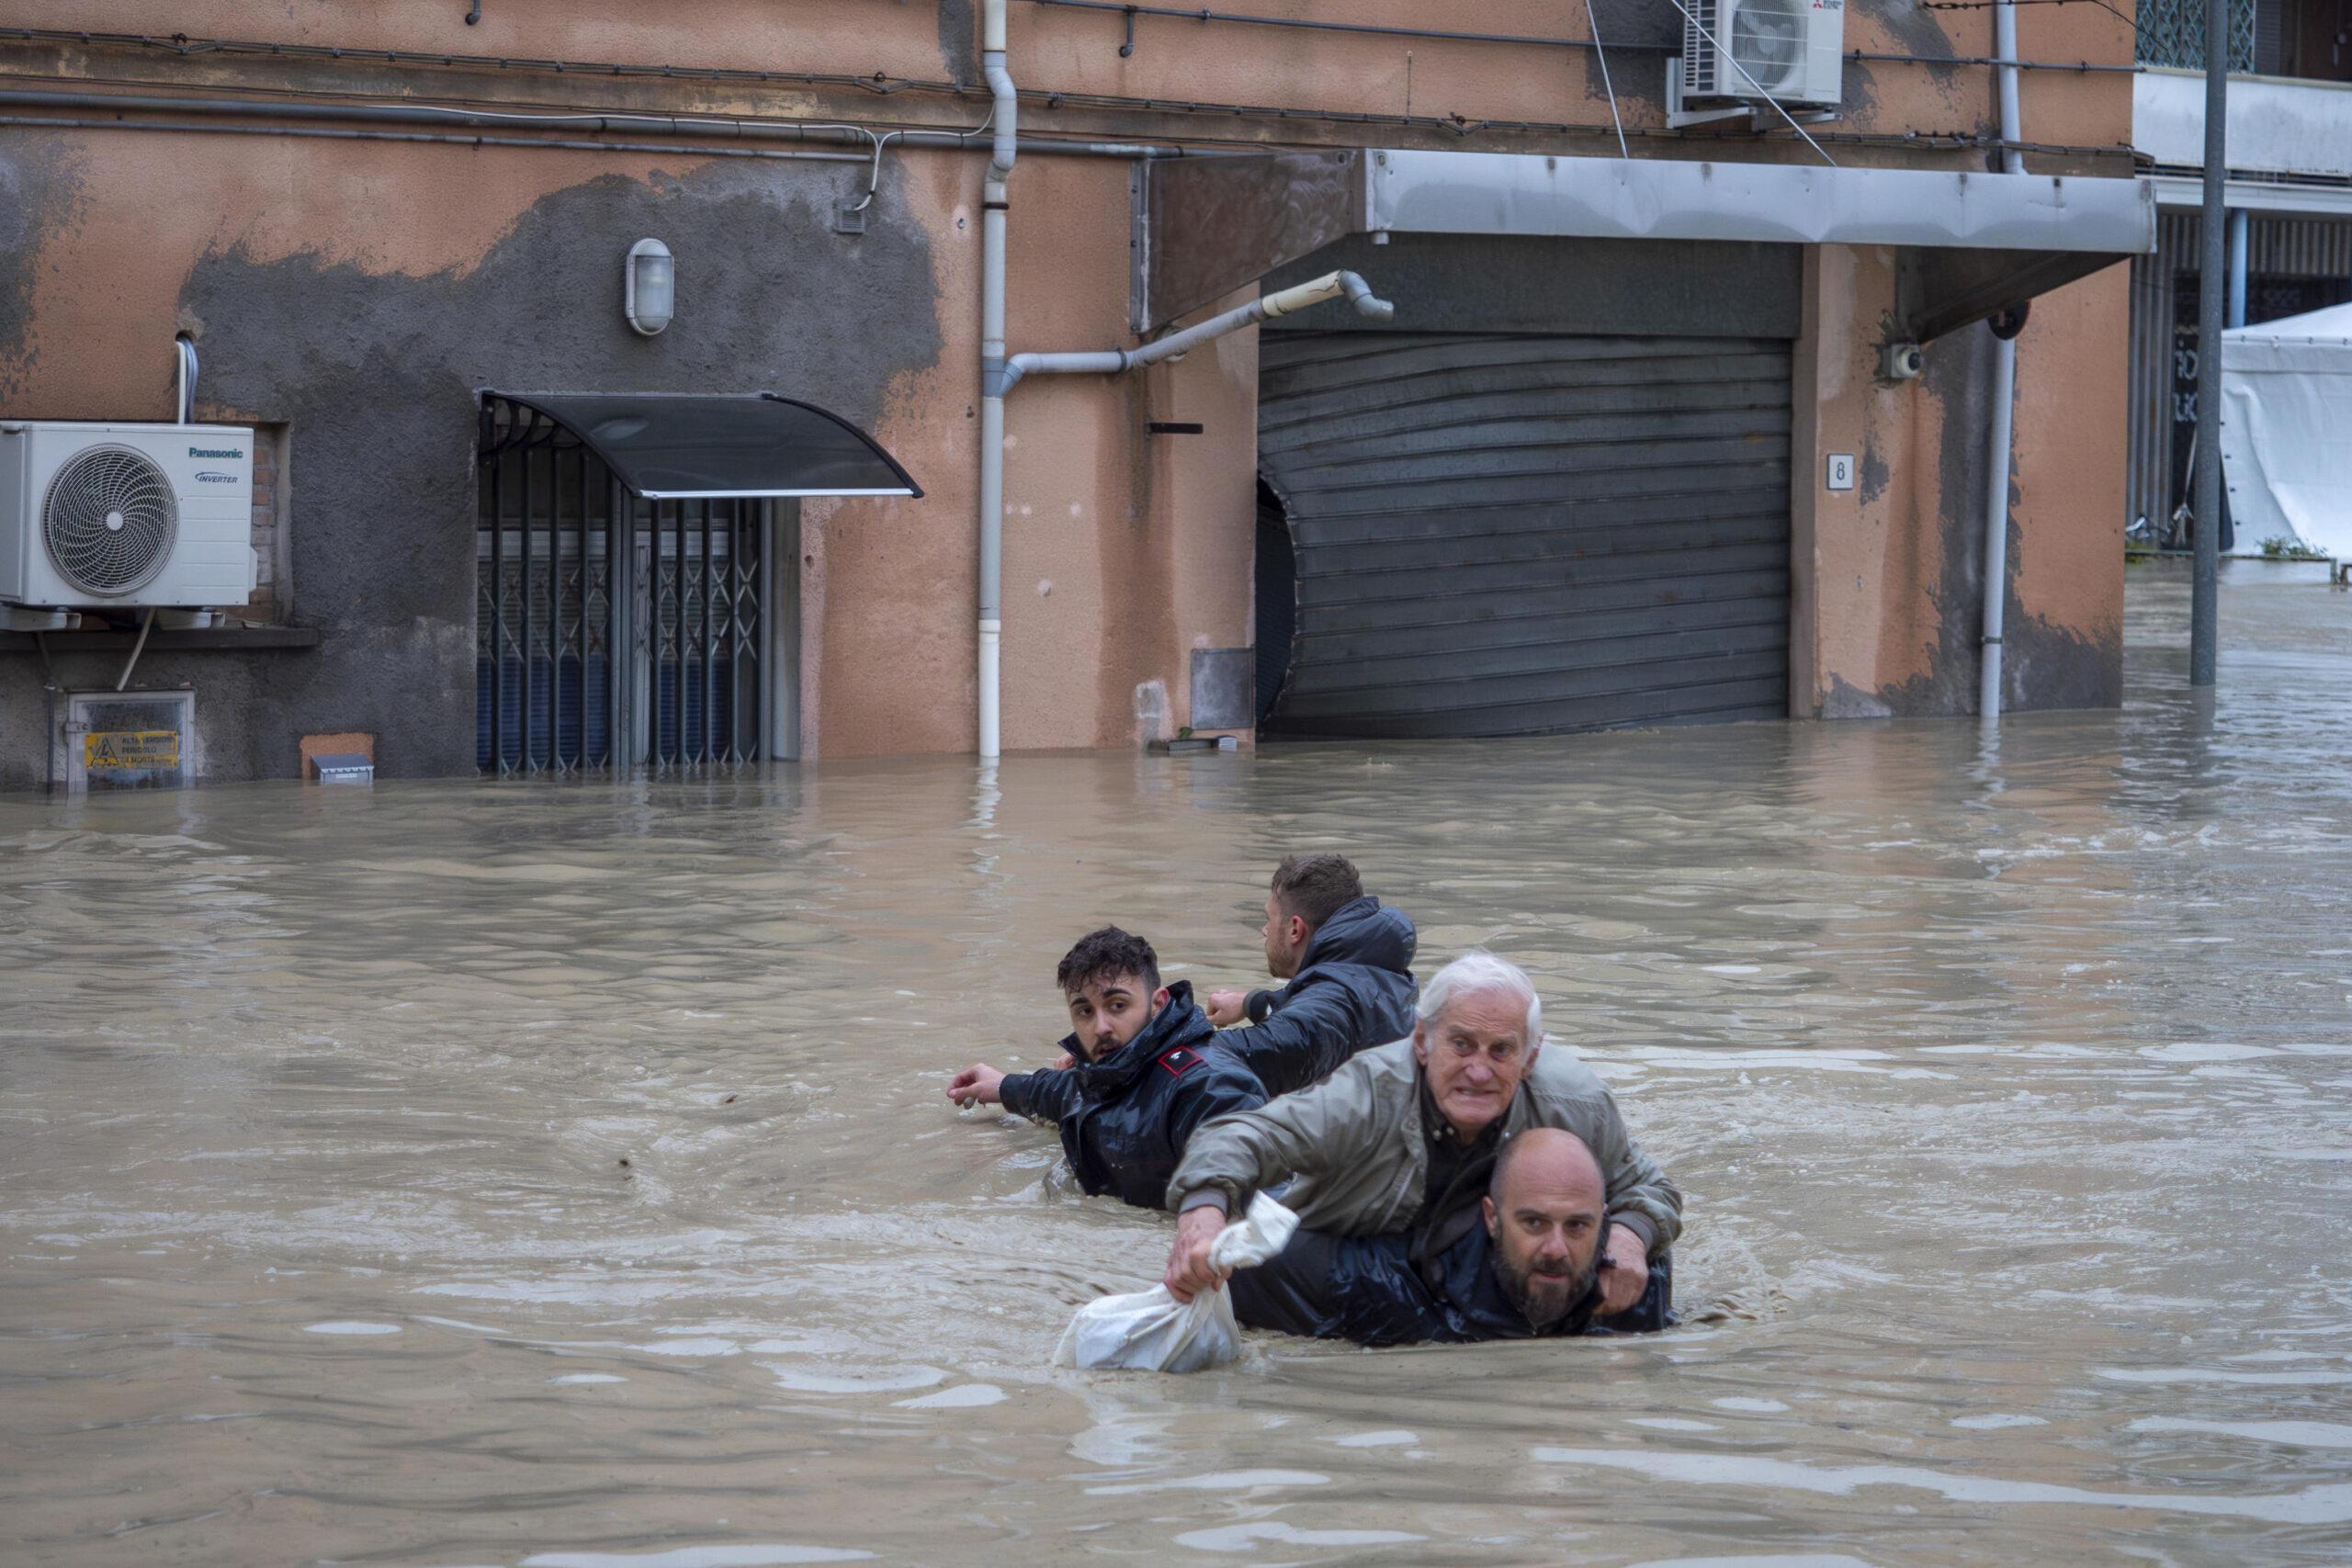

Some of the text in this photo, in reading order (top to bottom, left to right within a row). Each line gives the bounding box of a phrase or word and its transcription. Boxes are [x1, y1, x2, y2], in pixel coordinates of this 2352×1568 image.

[188, 446, 243, 459] Panasonic
[1837, 461, 1845, 480] 8
[198, 474, 238, 483] INVERTER
